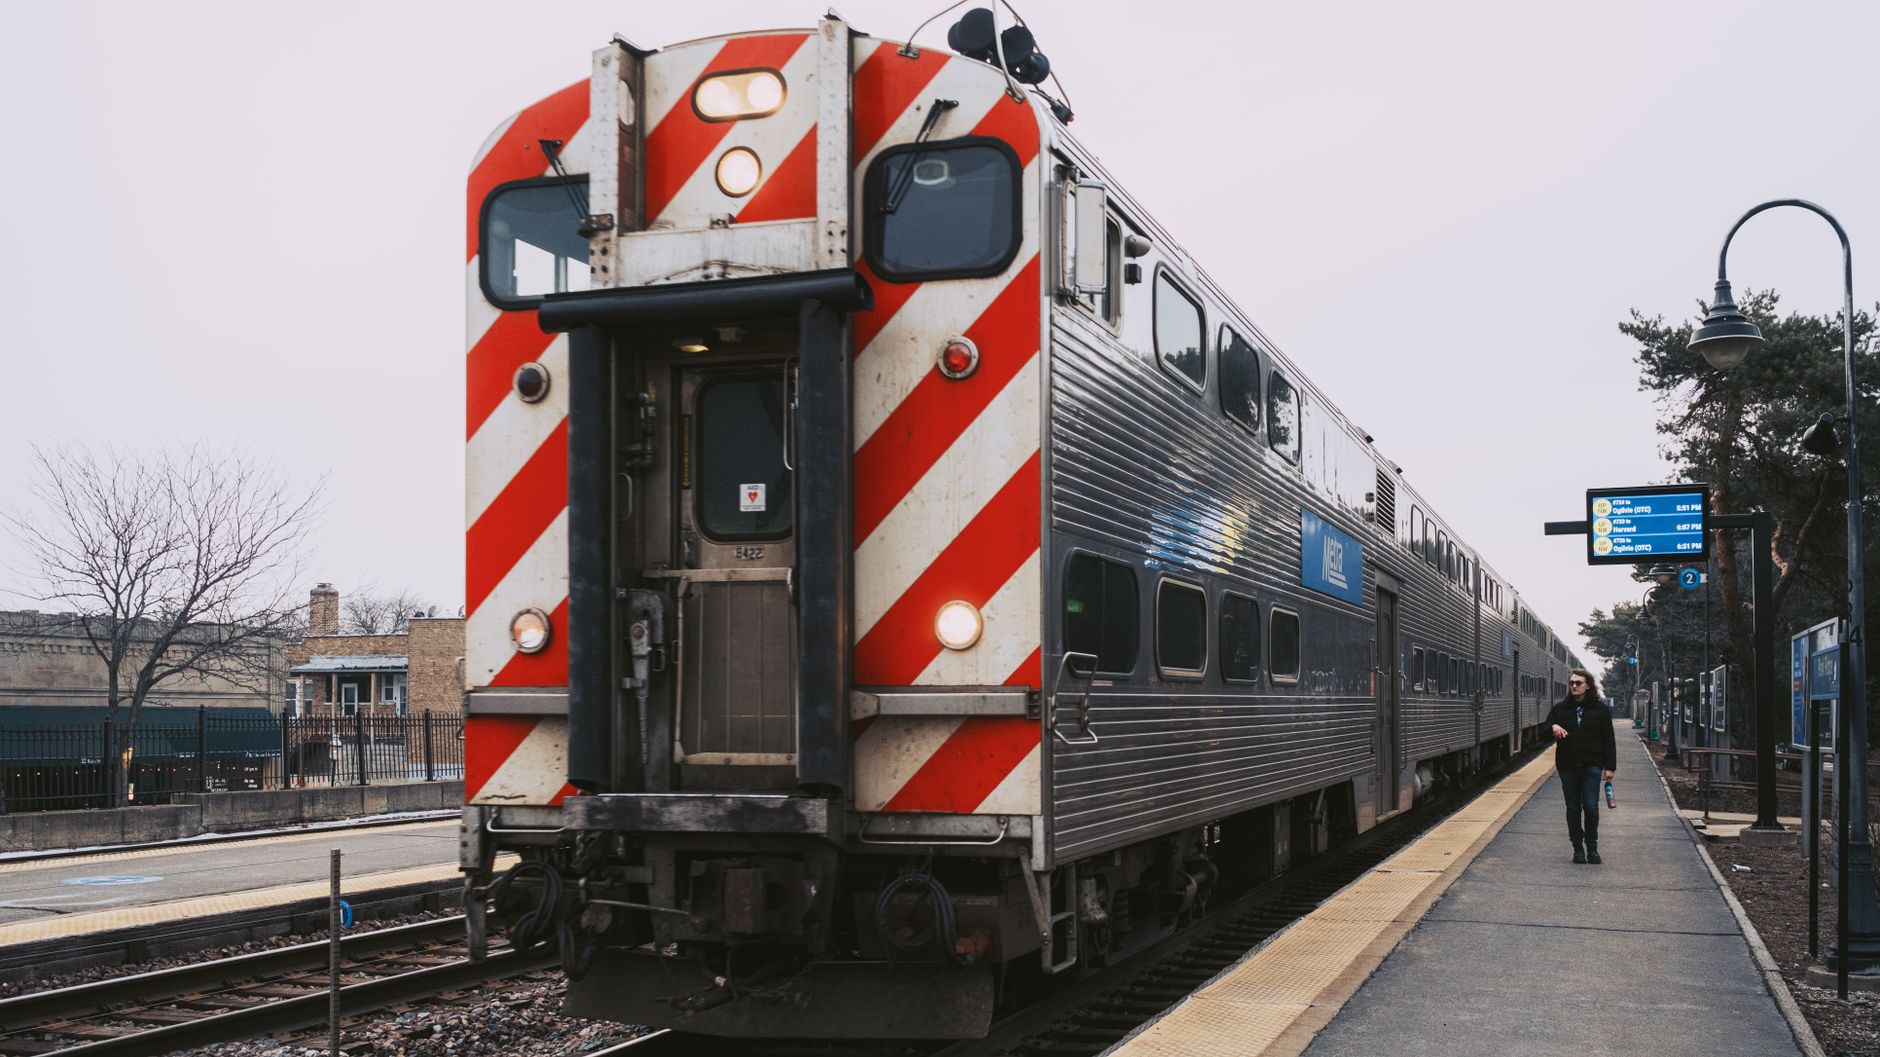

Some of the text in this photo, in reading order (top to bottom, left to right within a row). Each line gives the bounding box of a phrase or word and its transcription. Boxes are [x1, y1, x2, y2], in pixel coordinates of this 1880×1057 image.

[1634, 505, 1651, 514] (OTC)
[1612, 525, 1636, 533] Harvard
[736, 547, 764, 560] 8422
[1613, 544, 1652, 553] Ogilvie (OTC)
[1322, 534, 1343, 581] Metra
[1686, 573, 1694, 584] 2
